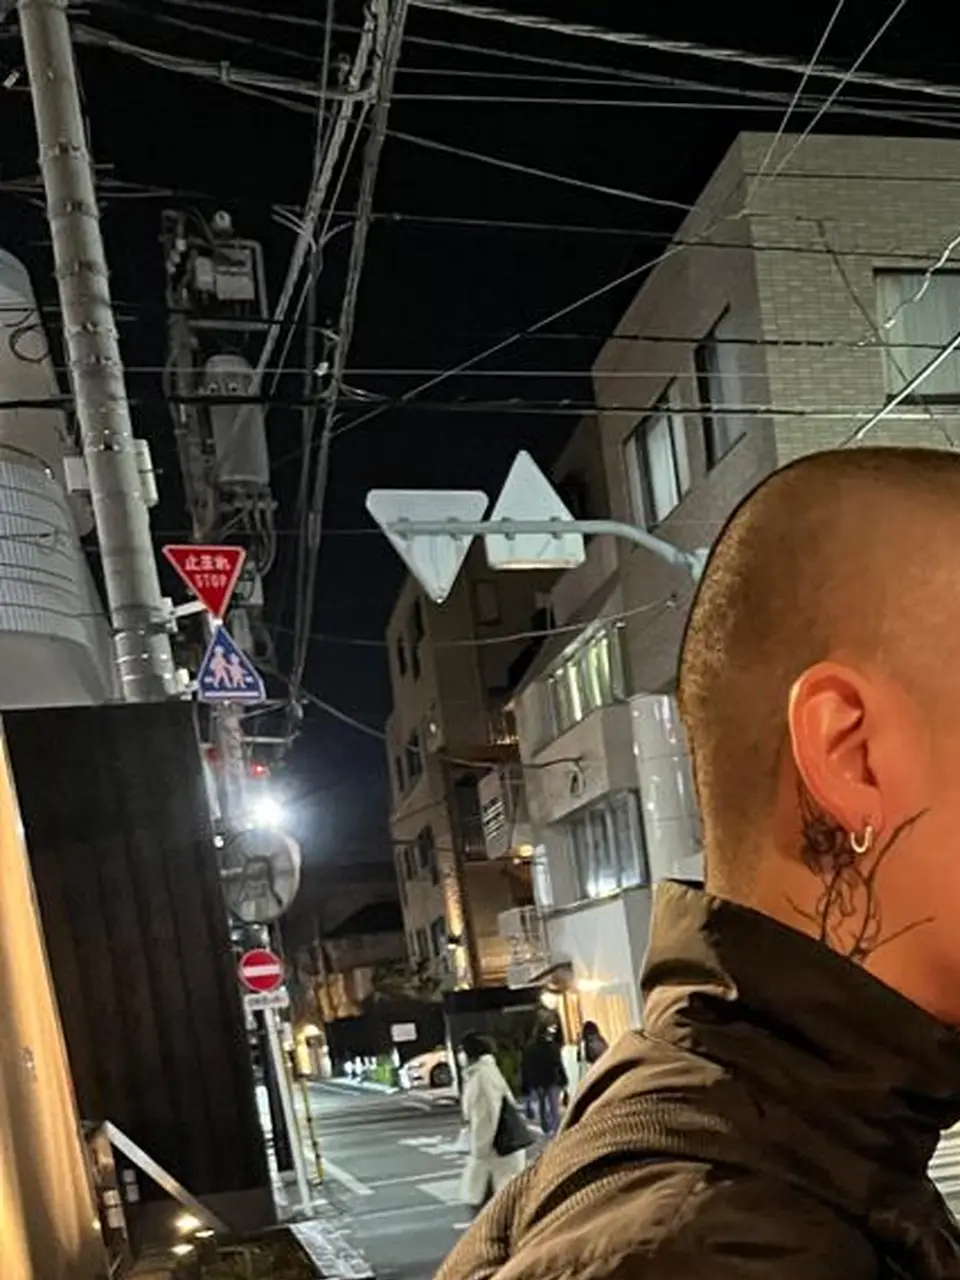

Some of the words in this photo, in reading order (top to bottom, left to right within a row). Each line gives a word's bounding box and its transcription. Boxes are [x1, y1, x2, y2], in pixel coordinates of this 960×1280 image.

[184, 553, 232, 571] 止まれ
[194, 573, 228, 589] STOP
